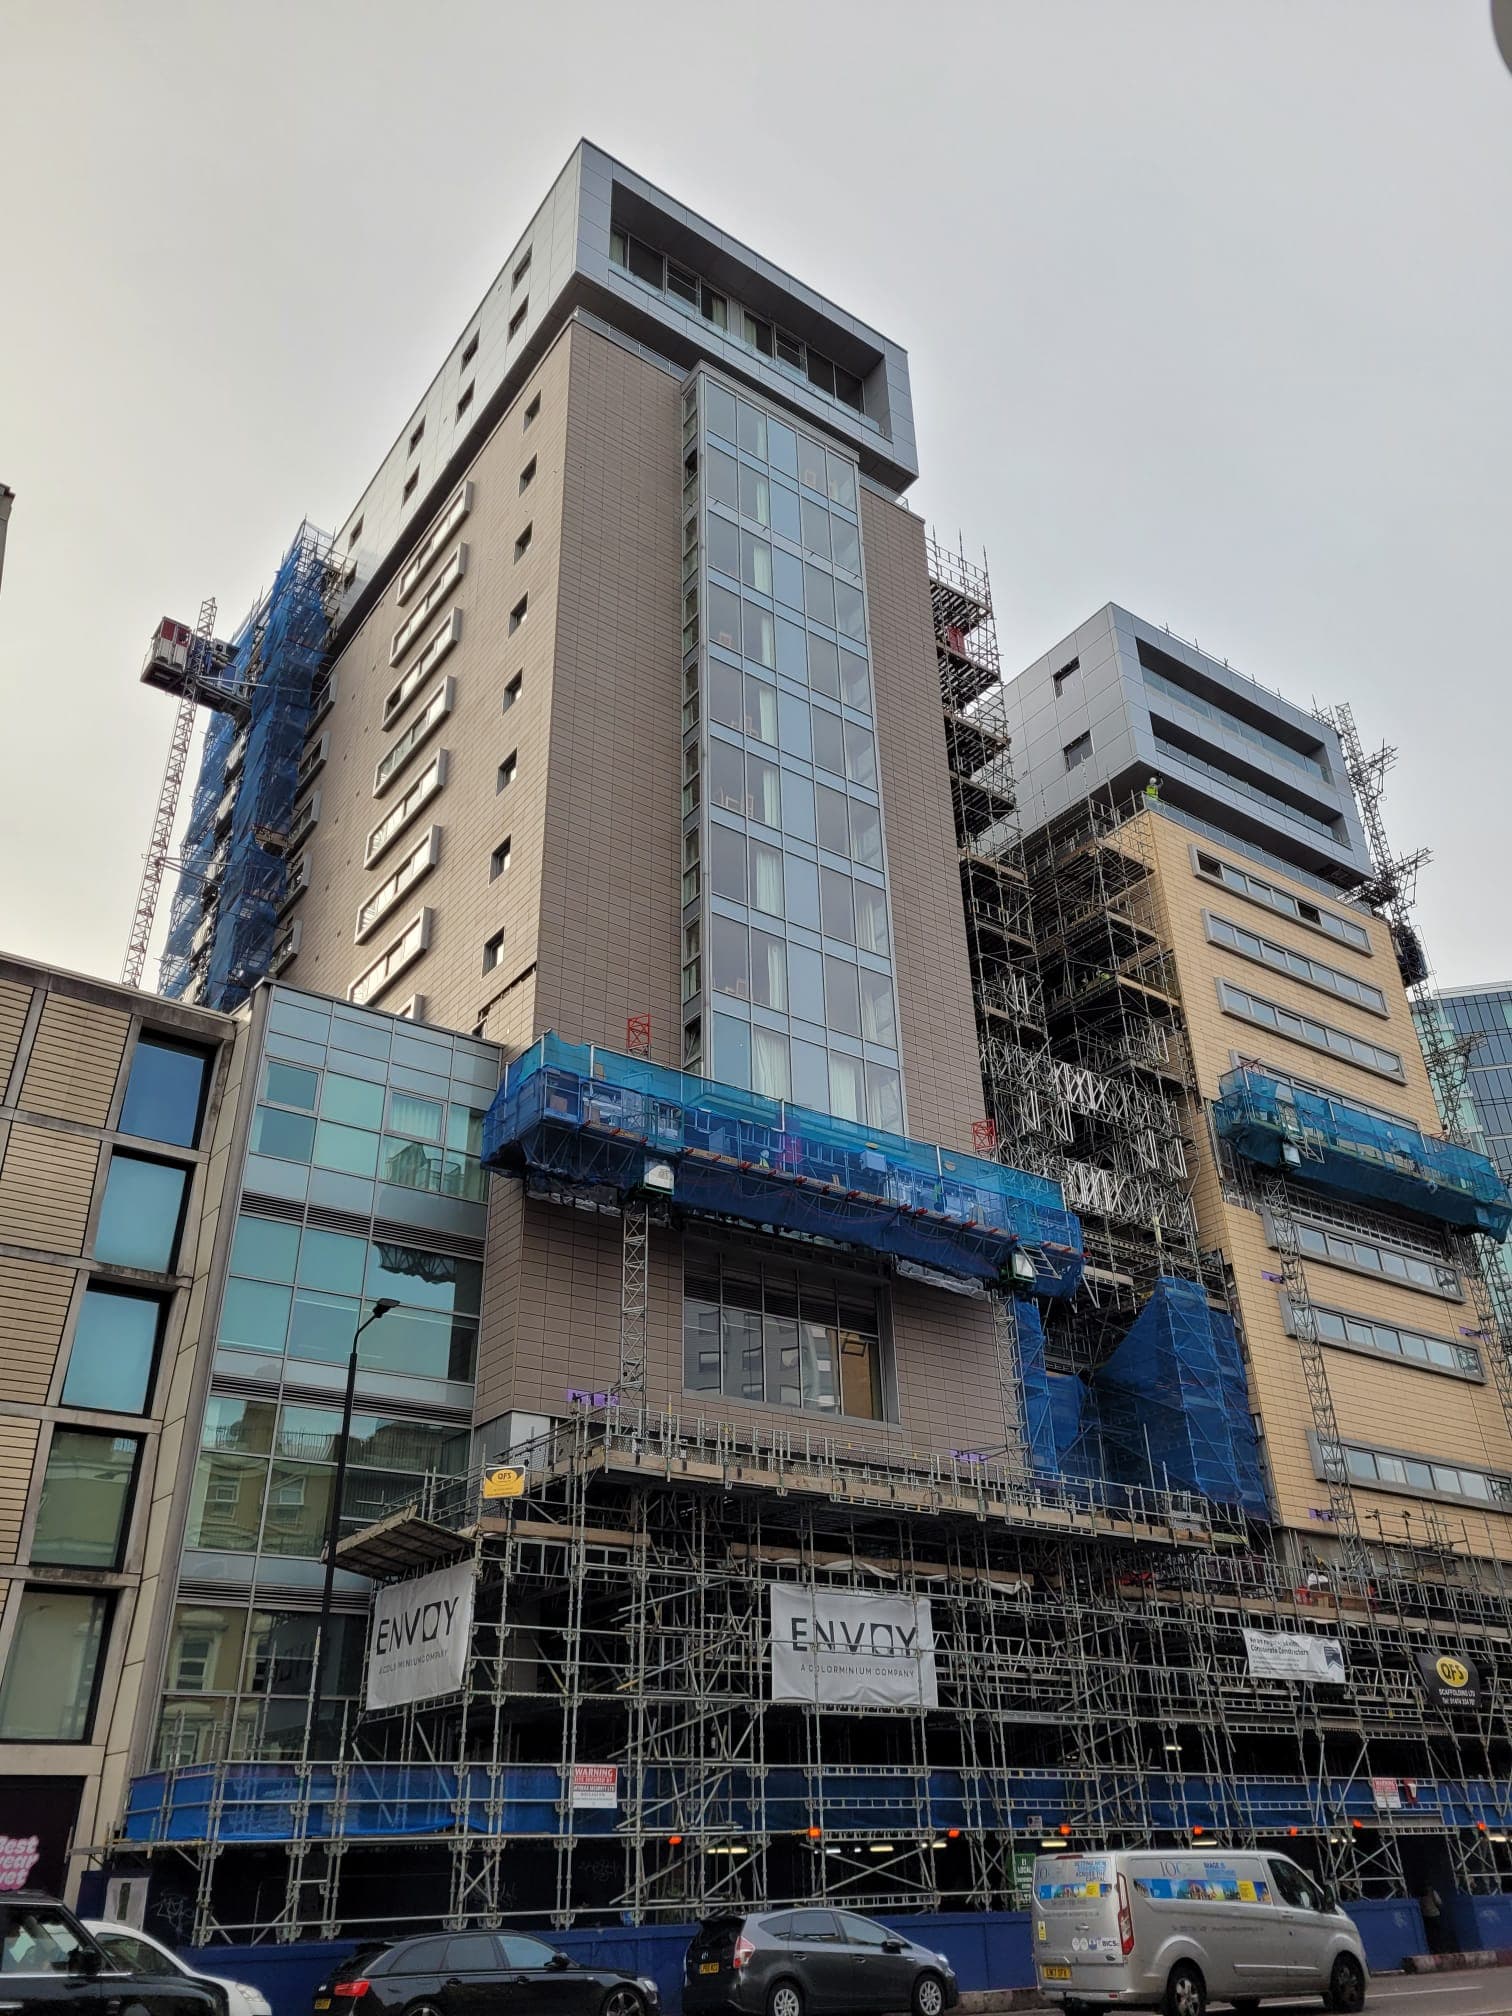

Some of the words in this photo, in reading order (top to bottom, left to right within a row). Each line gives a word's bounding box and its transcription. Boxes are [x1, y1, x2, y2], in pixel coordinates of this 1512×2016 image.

[498, 1472, 512, 1480] QFS
[376, 1596, 459, 1655] ENVOY
[791, 1617, 917, 1657] ENVOY
[875, 1668, 914, 1677] COMPANY
[1441, 1663, 1464, 1681] QFS
[574, 1767, 613, 1777] WARNING
